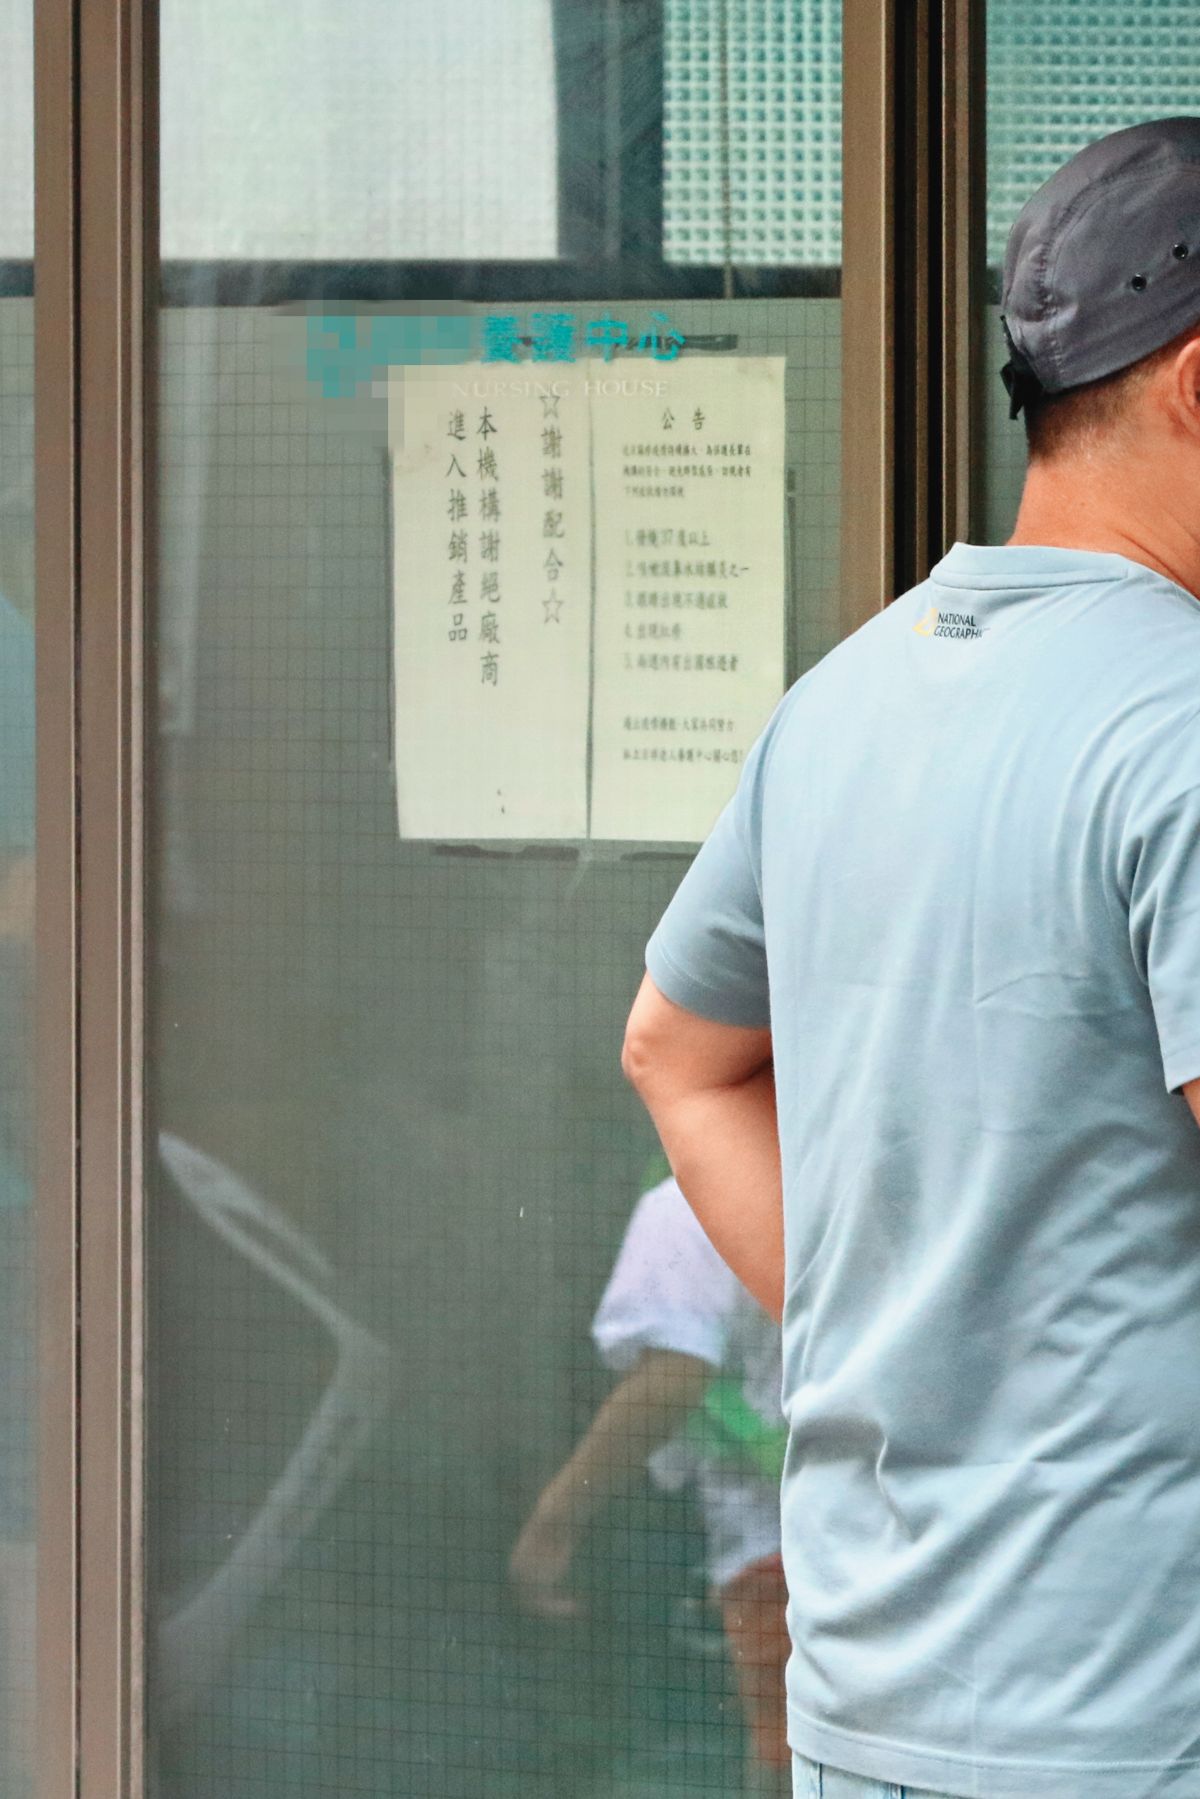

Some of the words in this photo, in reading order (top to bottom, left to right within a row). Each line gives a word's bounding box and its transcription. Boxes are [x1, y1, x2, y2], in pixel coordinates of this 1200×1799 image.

[452, 380, 570, 398] NURSING
[584, 380, 669, 397] HOUSE
[446, 408, 468, 642] 進入推銷產品
[477, 406, 501, 687] 本機構謝絕廠商
[938, 612, 976, 627] NATIONAL
